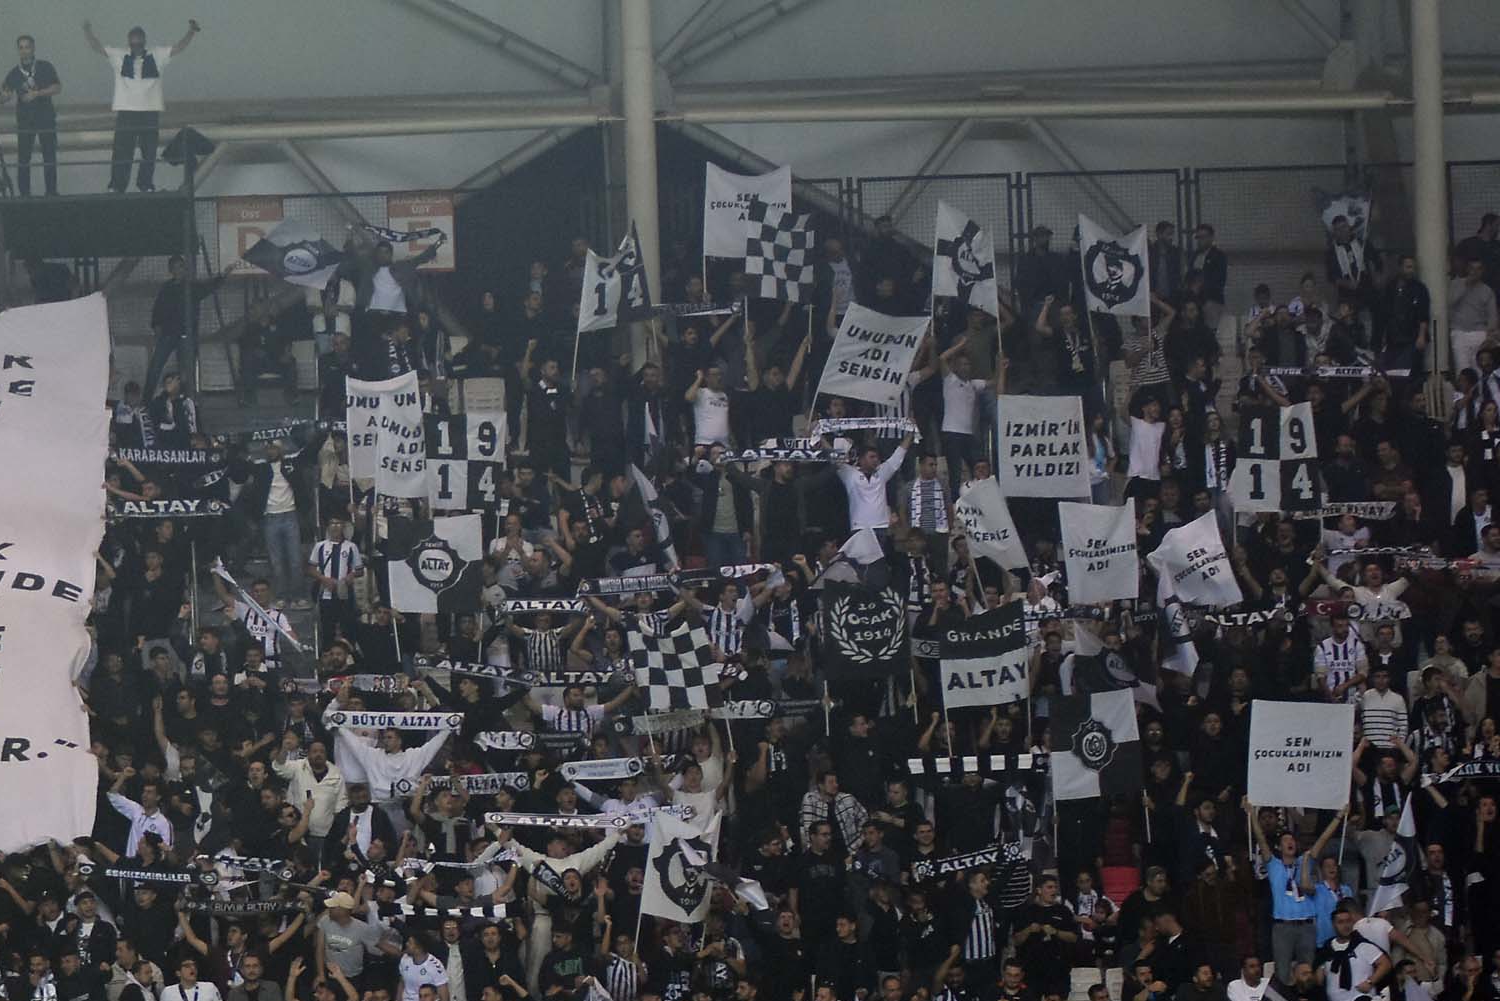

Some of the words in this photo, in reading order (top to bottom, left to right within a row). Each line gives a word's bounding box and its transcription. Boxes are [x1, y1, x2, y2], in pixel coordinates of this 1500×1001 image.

[846, 325, 918, 350] UMUDUN
[859, 350, 888, 367] ADI
[839, 361, 904, 385] SENSİN
[742, 449, 823, 460] ALTAY
[1010, 442, 1080, 458] PARLAK
[1014, 463, 1080, 479] YILDIZI
[124, 499, 201, 515] ALTAY
[1186, 547, 1207, 562] SEN
[421, 558, 451, 571] ALTAY
[1087, 560, 1109, 572] ADI
[1201, 564, 1222, 582] ADI
[511, 601, 580, 611] ALTAY
[847, 611, 892, 626] OCAK
[854, 628, 892, 641] 1914
[946, 619, 1022, 644] GRANDE
[436, 659, 513, 679] ALTAY
[947, 661, 1027, 691] ALTAY
[541, 671, 613, 686] ALTAY
[351, 711, 396, 728] BÜYÜK
[399, 714, 442, 729] ALTAY
[1286, 737, 1311, 748] SEN
[1255, 750, 1343, 760] ÇOCUKLARIMIZIN
[1286, 763, 1311, 773] ADI
[517, 815, 599, 828] ALTAY
[940, 851, 998, 874] ALTAY
